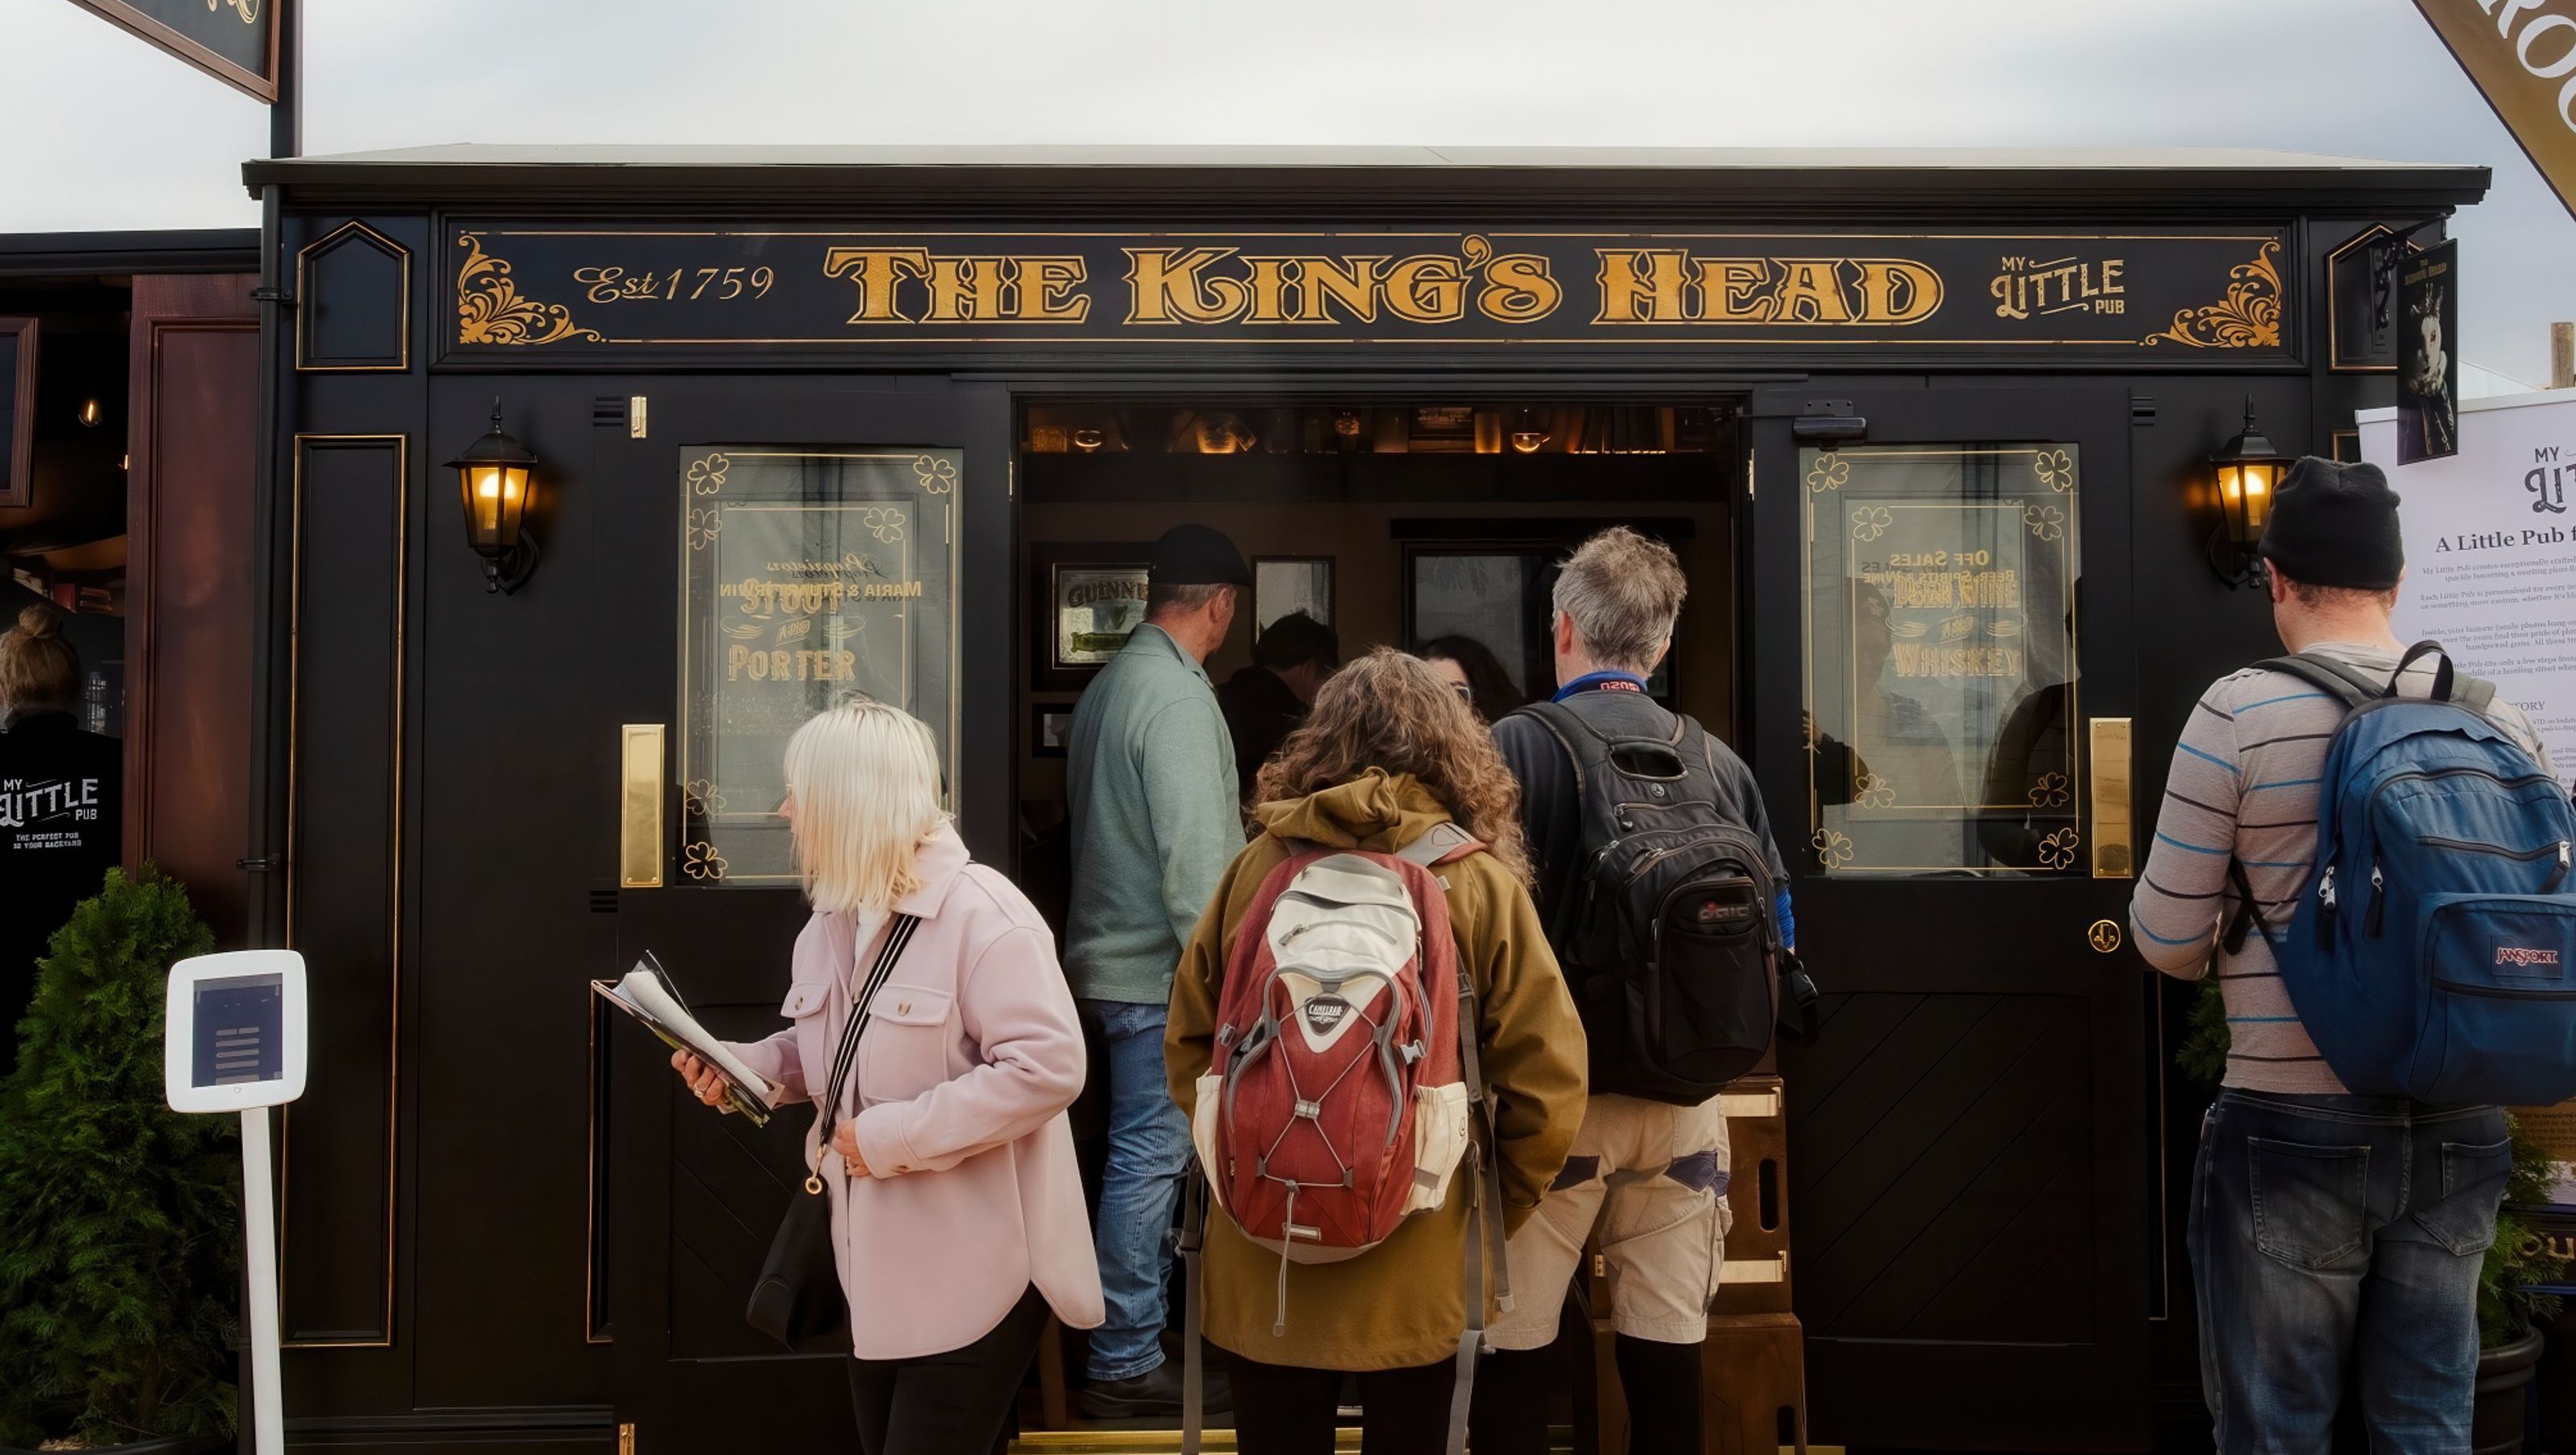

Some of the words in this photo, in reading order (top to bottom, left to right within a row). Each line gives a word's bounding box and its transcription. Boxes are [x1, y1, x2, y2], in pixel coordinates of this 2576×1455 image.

[2002, 257, 2025, 271] MY
[573, 267, 659, 303] Est
[666, 266, 774, 300] 1759
[824, 246, 1091, 324] THE
[1121, 234, 1563, 325] KING'S
[1589, 248, 1945, 325] HEAD
[1990, 259, 2124, 320] LITTLE
[2095, 300, 2124, 315] PUB
[2534, 446, 2559, 463] MY
[2435, 537, 2452, 553] A
[2457, 531, 2516, 551] Little
[2520, 527, 2565, 545] Pub
[1068, 580, 1148, 608] GUINNE
[728, 644, 855, 681] PORTER
[1893, 643, 2020, 676] WHISKEY
[3, 779, 23, 792] MY
[0, 778, 98, 828] LITTLE
[75, 808, 97, 821] PUB
